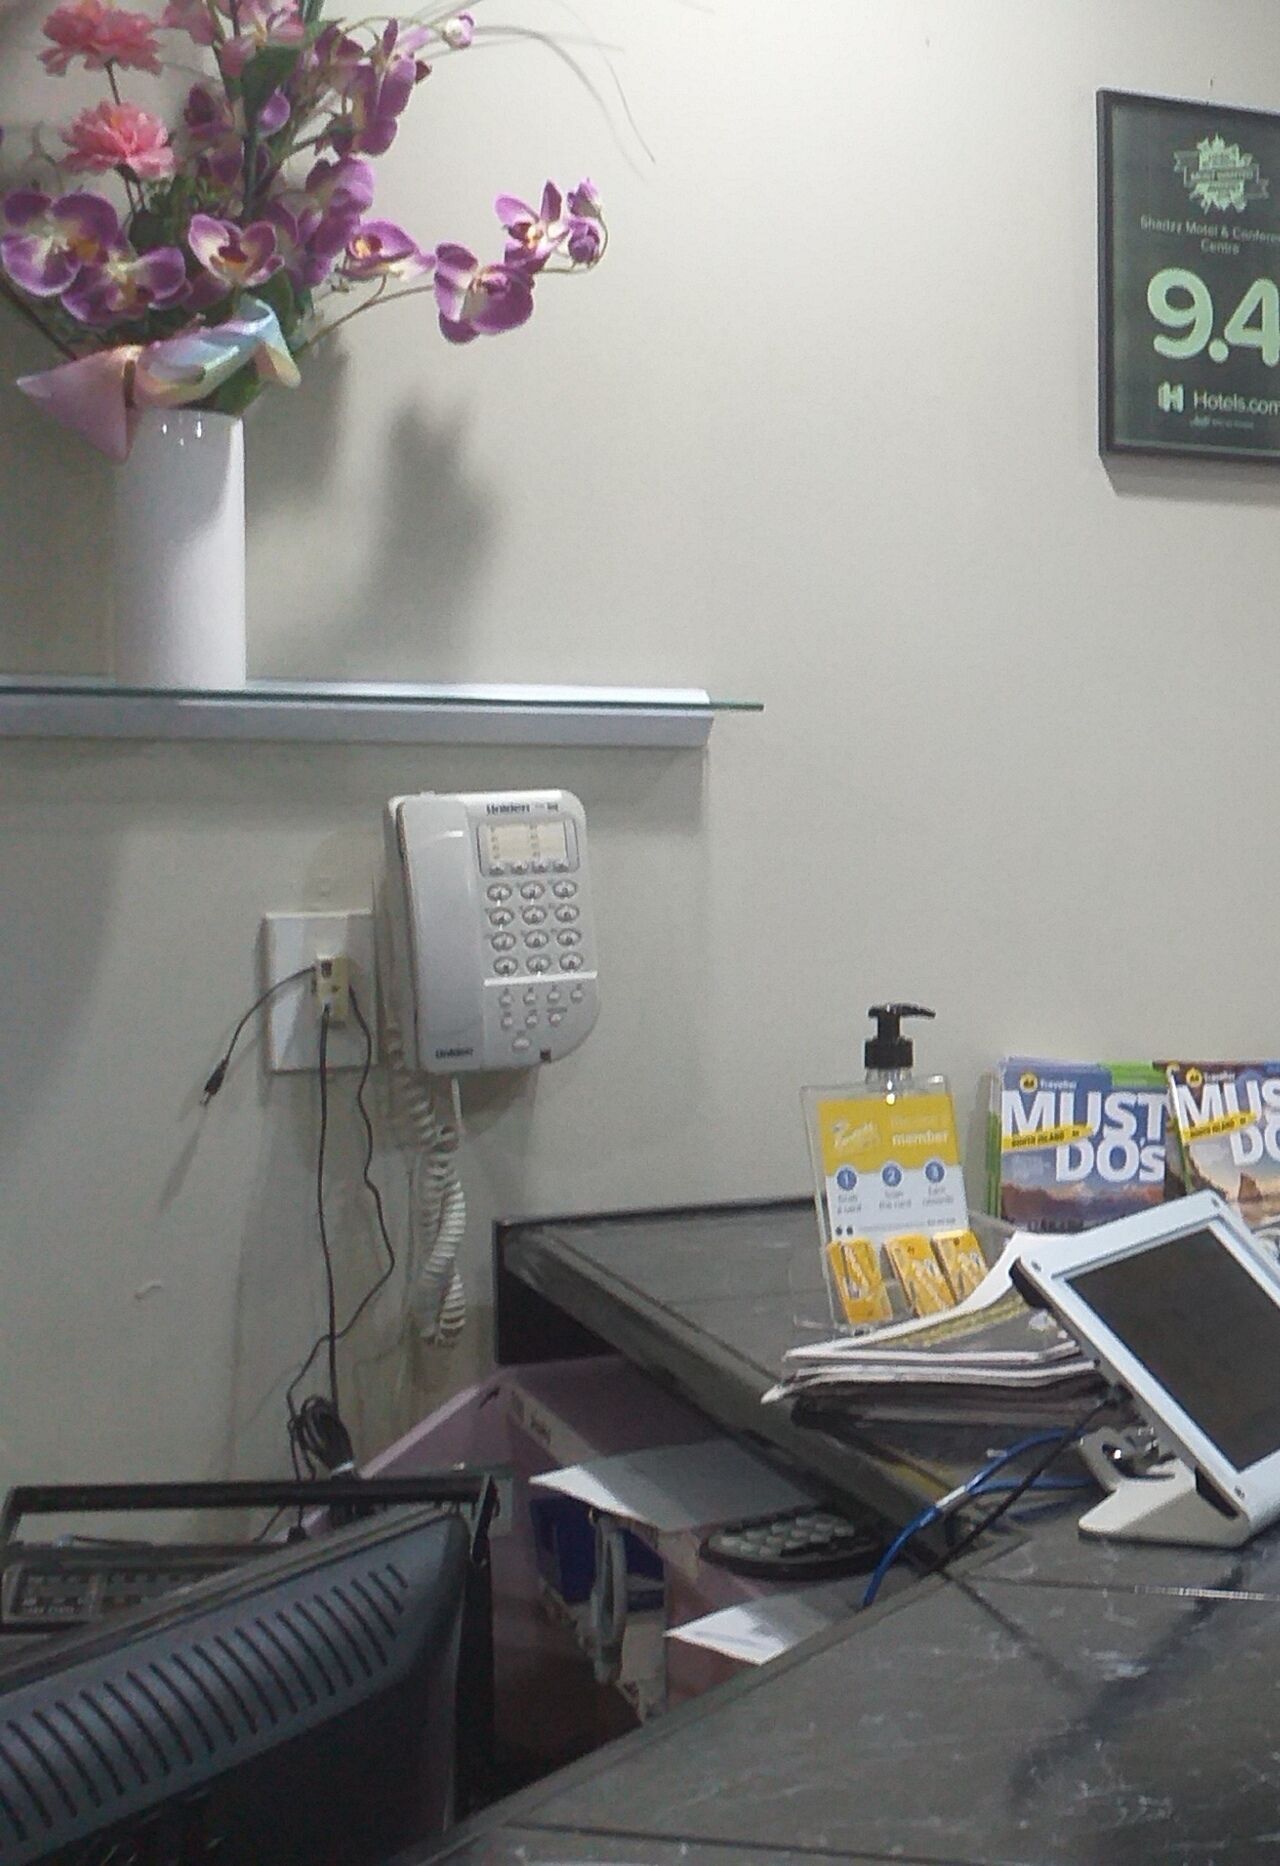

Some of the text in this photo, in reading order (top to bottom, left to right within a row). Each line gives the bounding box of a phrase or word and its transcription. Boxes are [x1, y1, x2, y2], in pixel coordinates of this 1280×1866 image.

[1186, 221, 1218, 237] Motel
[1200, 237, 1240, 255] Centre
[1001, 1089, 1169, 1142] MUST
[1056, 1136, 1166, 1183] DO's
